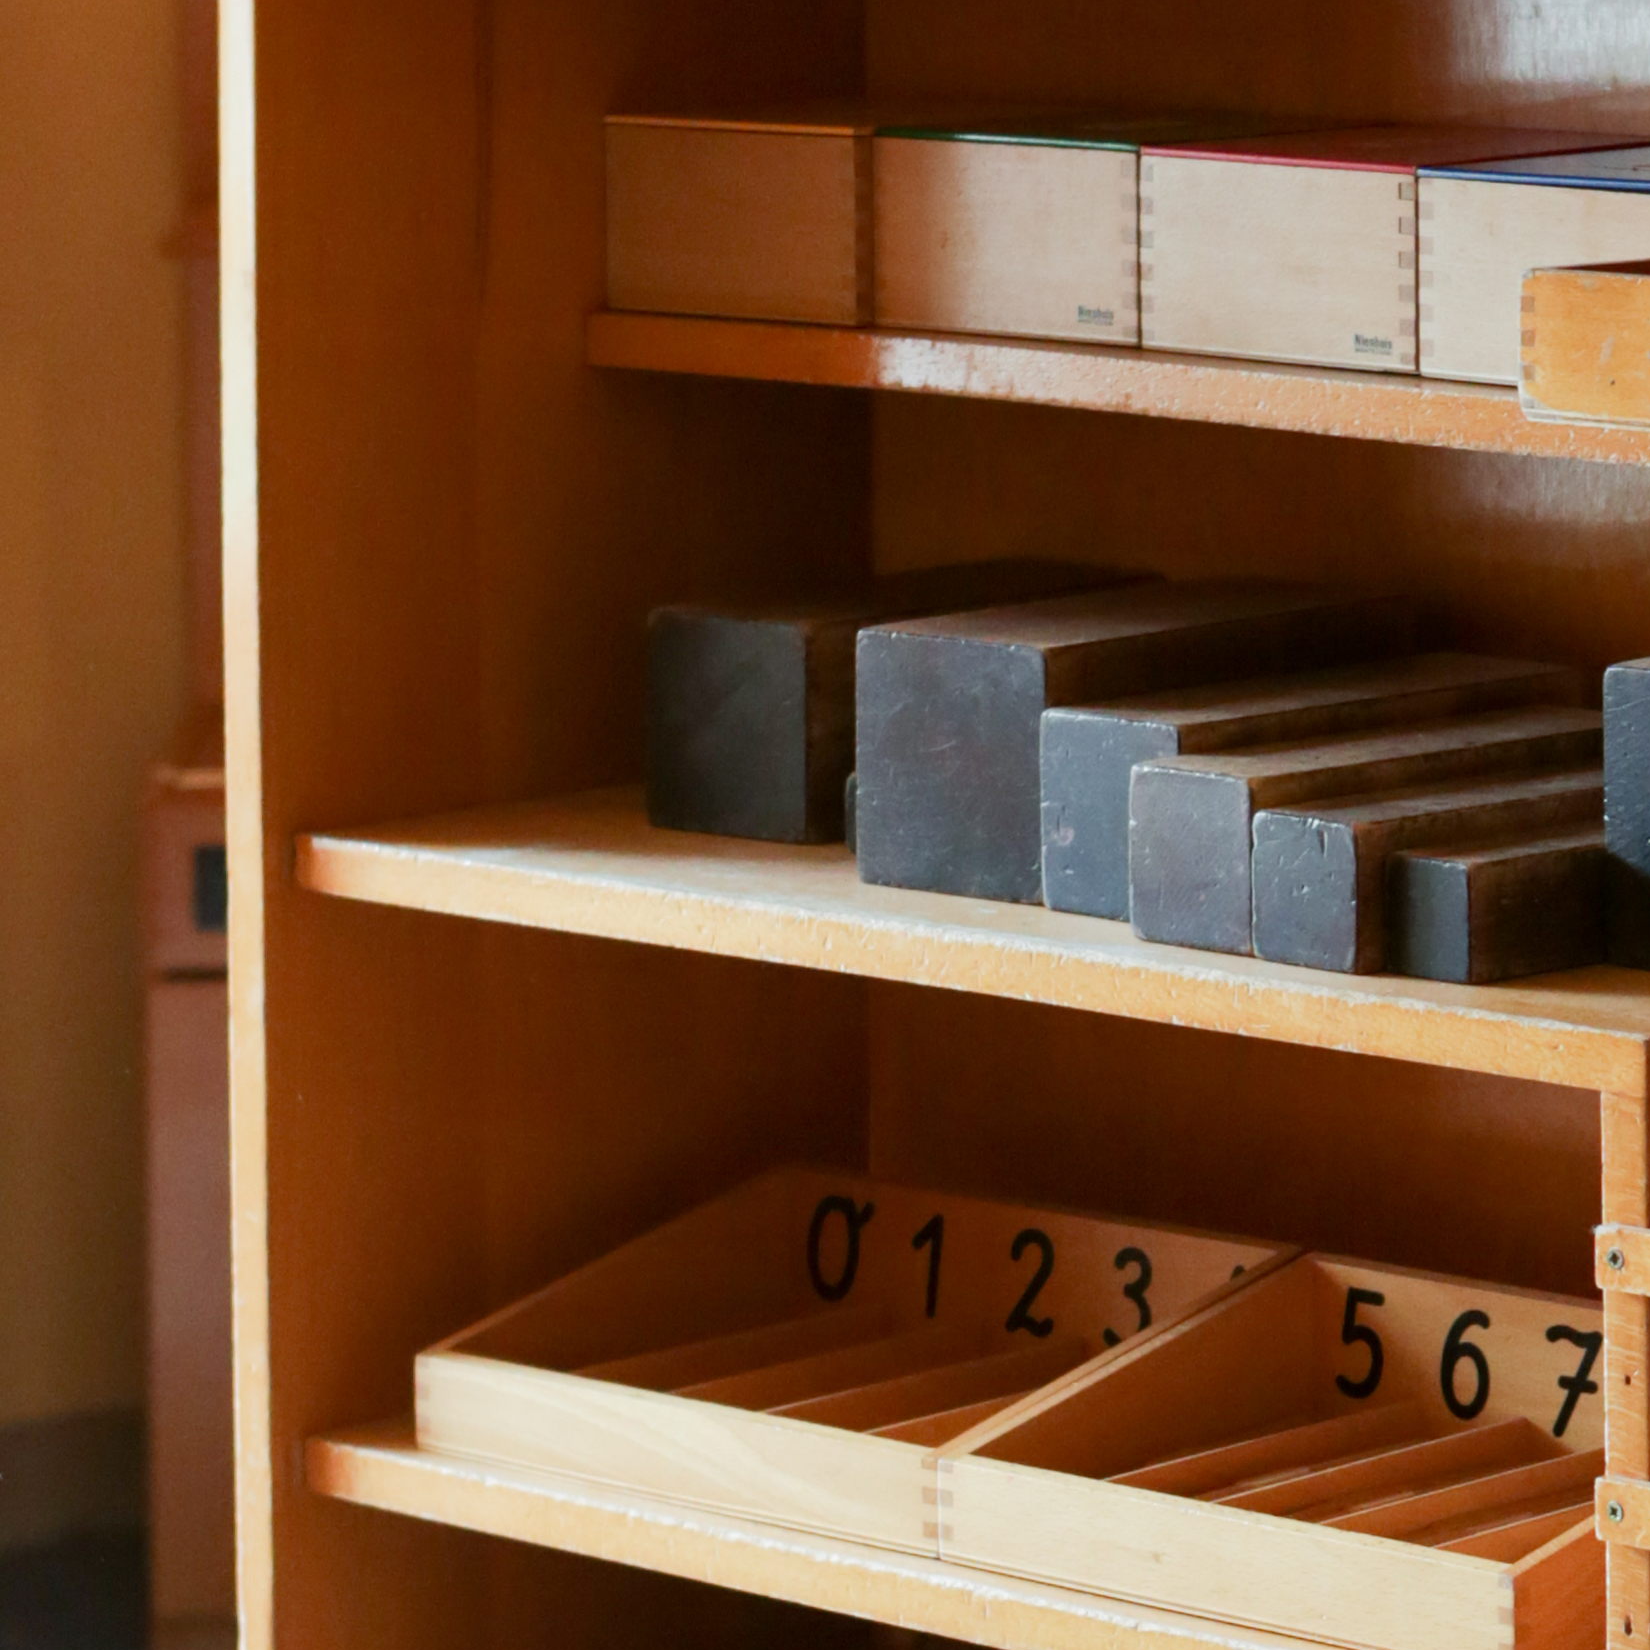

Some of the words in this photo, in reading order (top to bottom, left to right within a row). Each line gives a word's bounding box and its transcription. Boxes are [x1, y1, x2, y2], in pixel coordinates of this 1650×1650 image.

[911, 1214, 944, 1319] 1
[1006, 1227, 1055, 1338] 2
[1102, 1247, 1152, 1347] 3
[1335, 1286, 1385, 1399] 5
[1440, 1309, 1490, 1420] 6
[1545, 1323, 1602, 1438] 7
